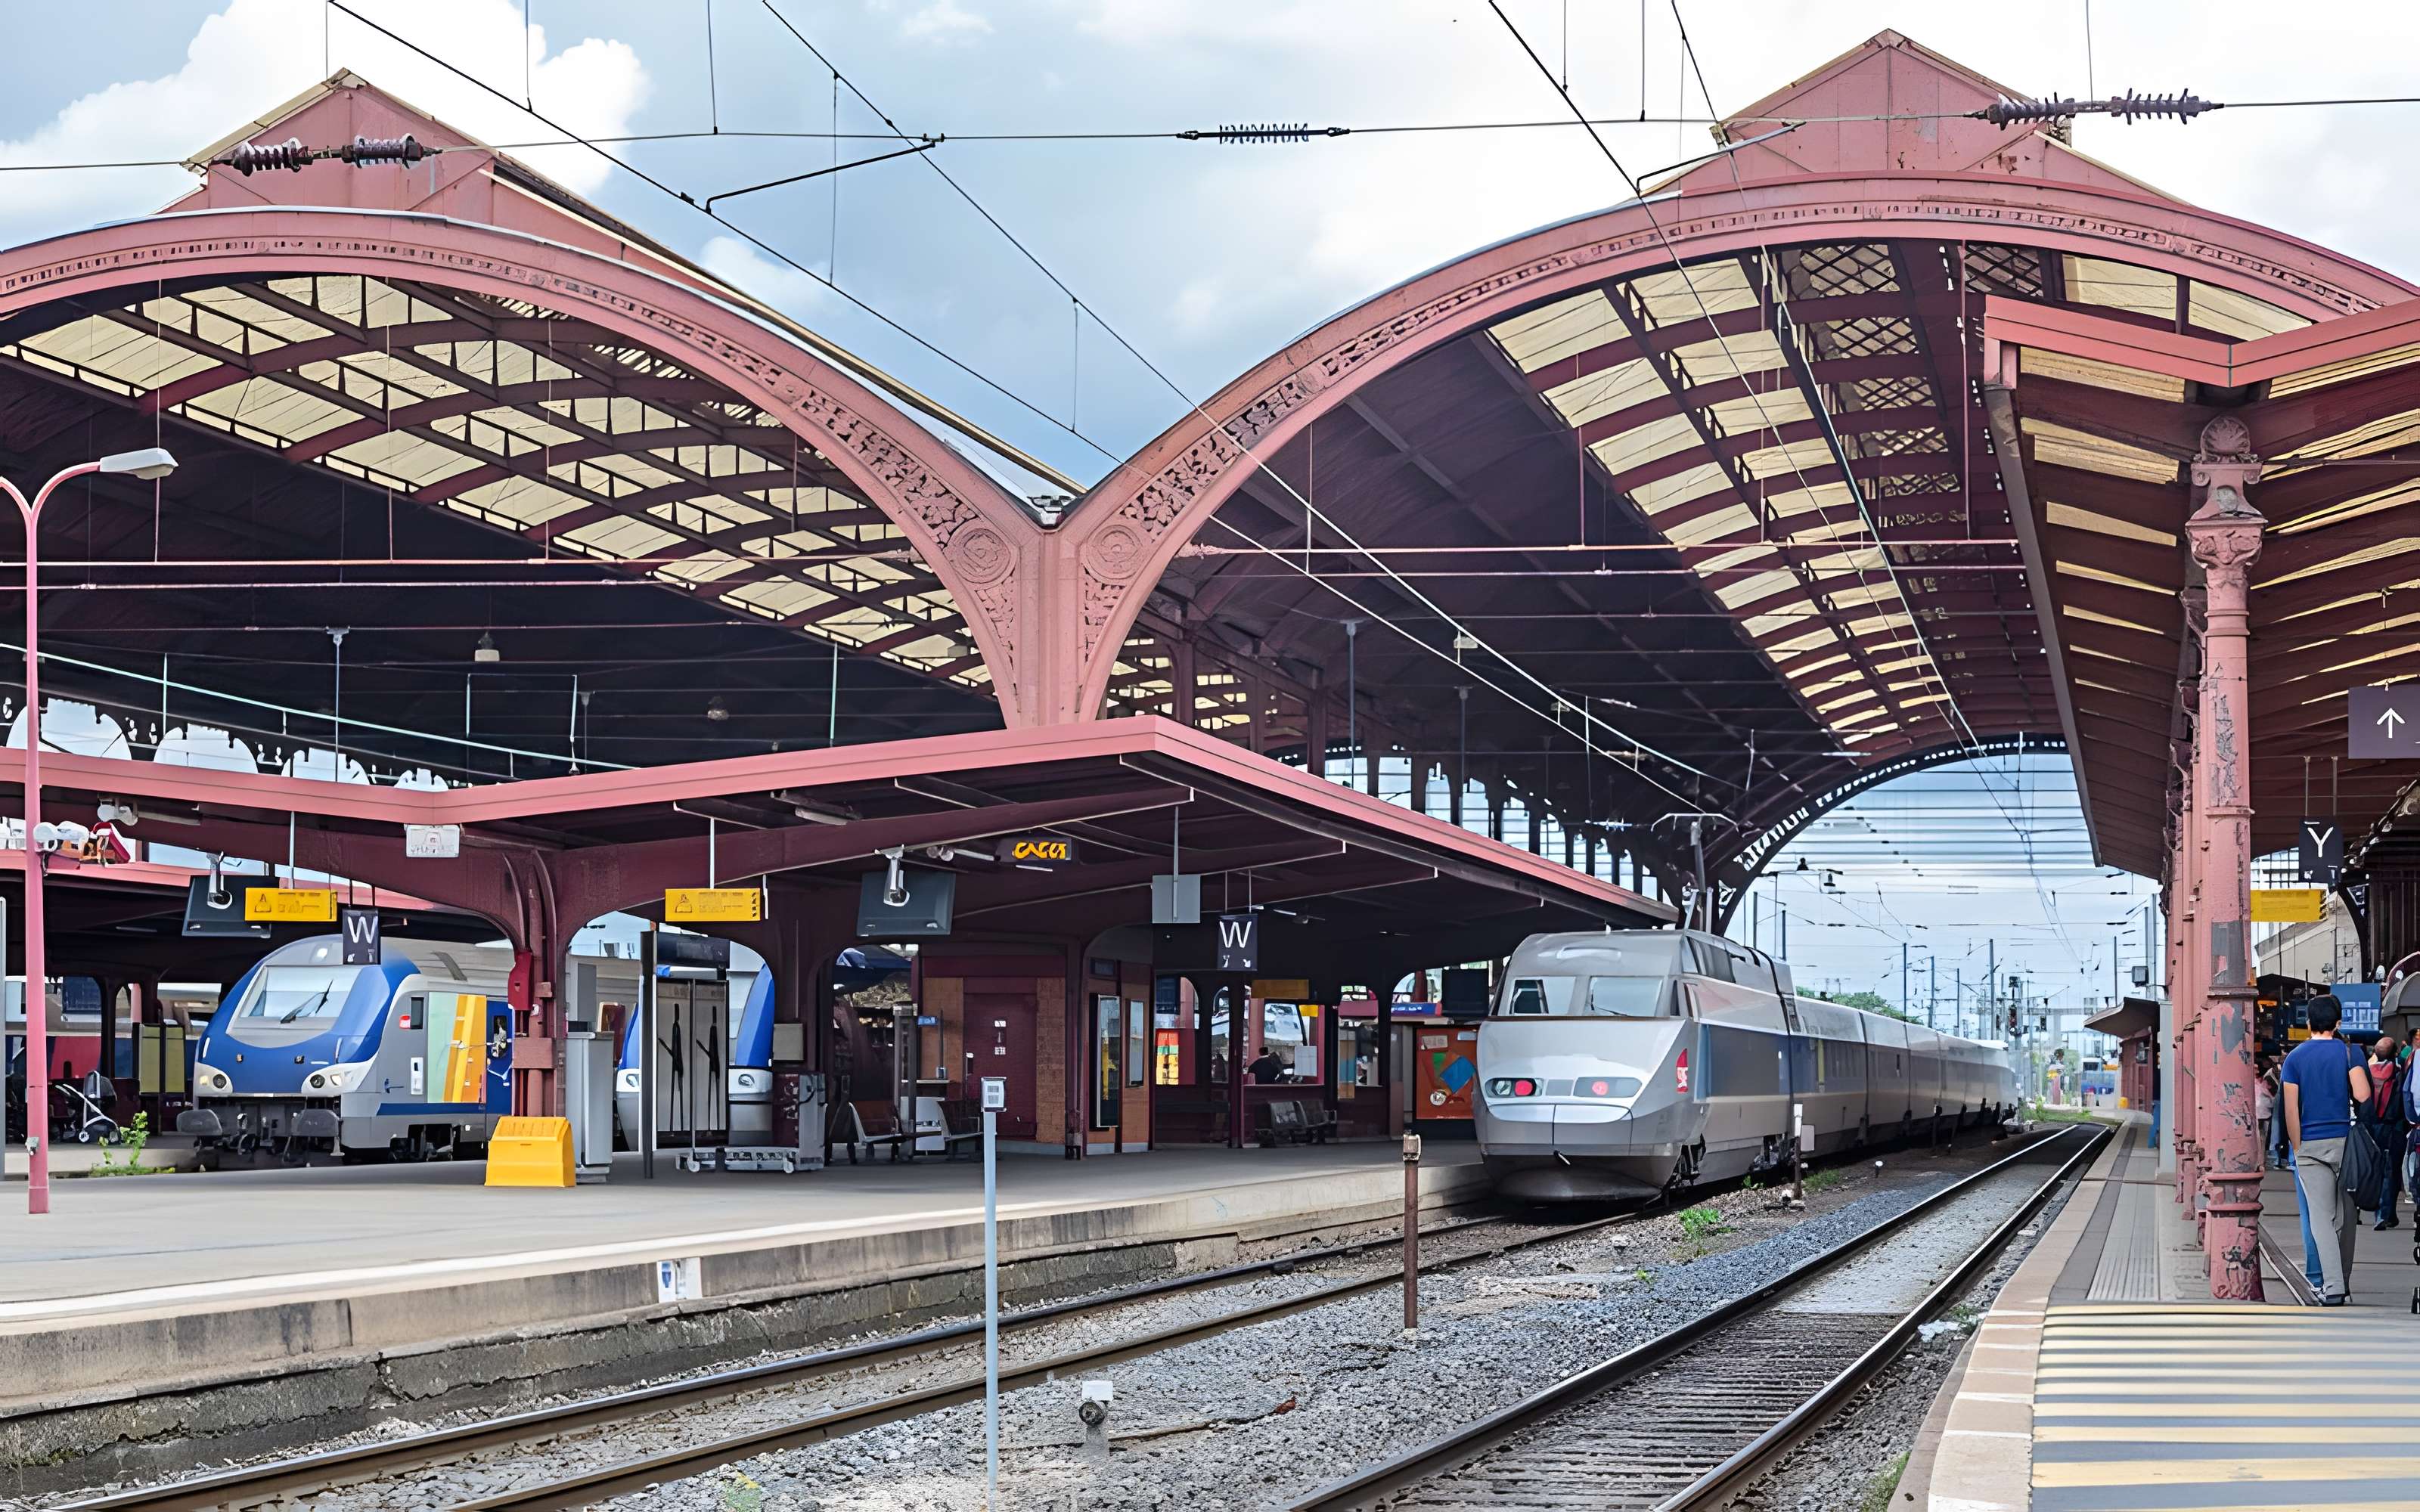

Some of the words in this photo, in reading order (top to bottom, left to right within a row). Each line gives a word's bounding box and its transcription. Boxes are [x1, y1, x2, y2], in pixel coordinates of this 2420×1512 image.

[2307, 826, 2334, 858] Y
[347, 916, 379, 943] W
[1219, 921, 1252, 948] W
